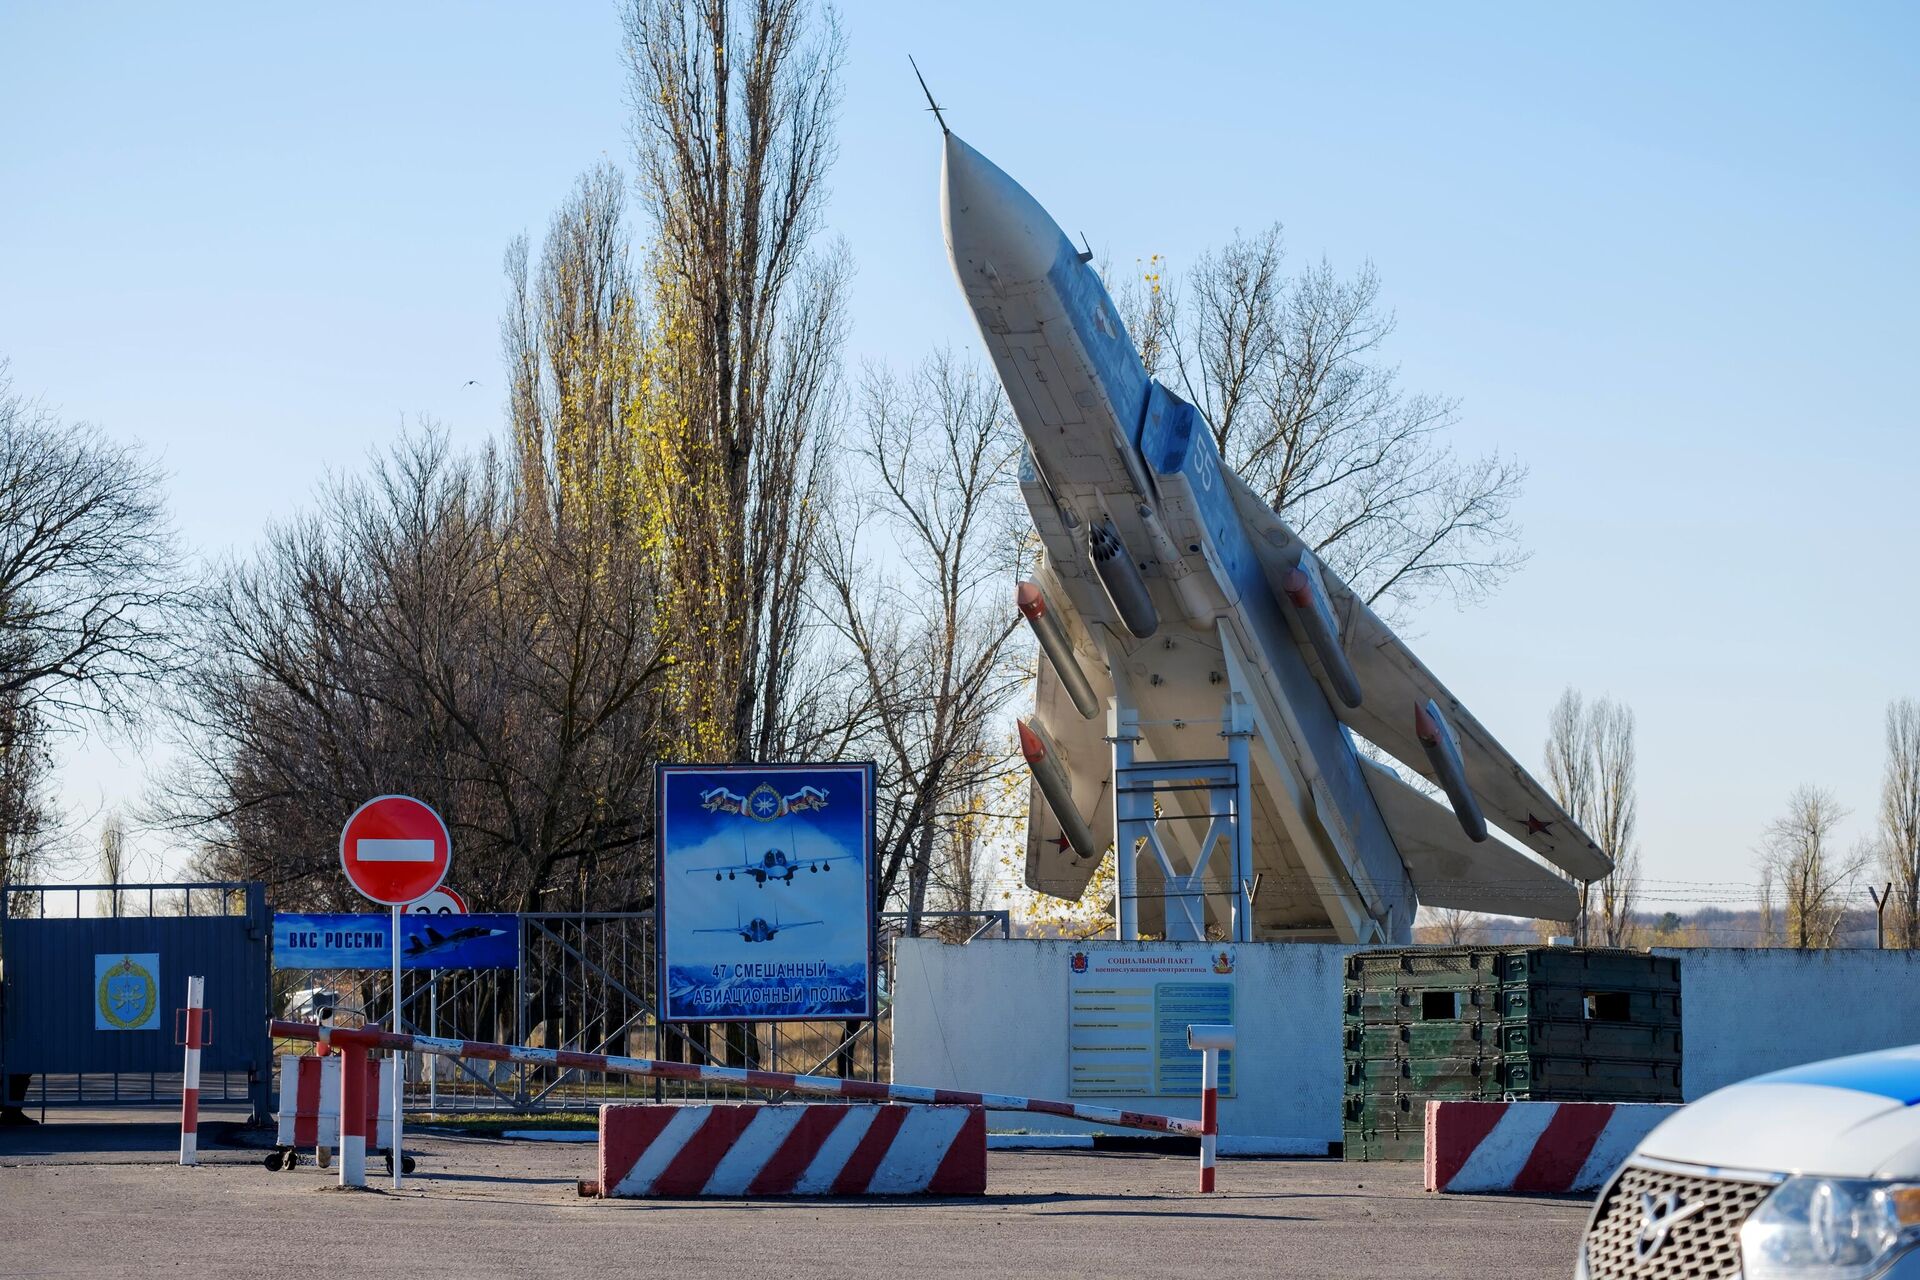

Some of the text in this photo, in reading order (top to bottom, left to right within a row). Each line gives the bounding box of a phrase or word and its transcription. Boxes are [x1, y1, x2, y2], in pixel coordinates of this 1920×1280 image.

[1194, 432, 1215, 492] 55
[289, 932, 383, 949] ВКС РОССИИ
[712, 960, 828, 978] 47 СМЕШАННЫЙ
[1107, 956, 1194, 966] СОЦИАЛЬНЫЙ ПАКЕТ
[693, 984, 849, 1006] АВИАЦИОННЫЙ ПОЛК
